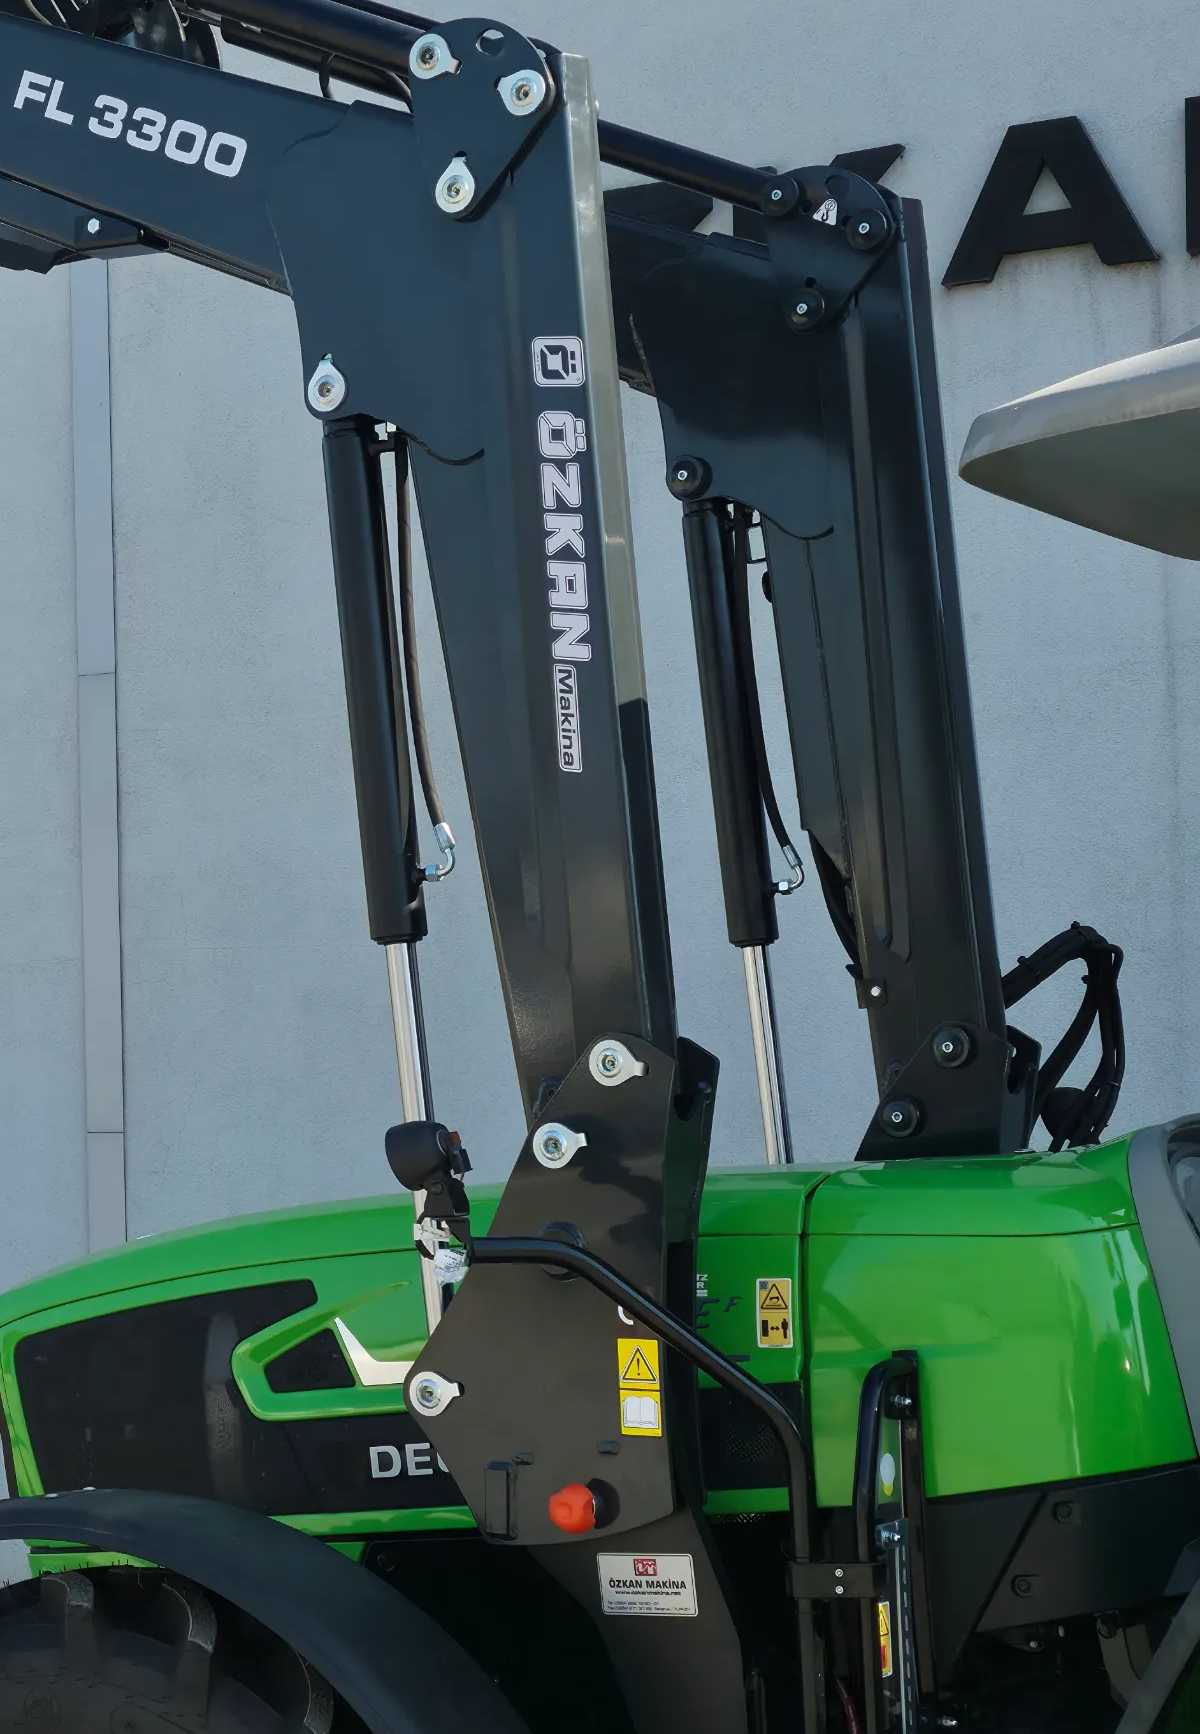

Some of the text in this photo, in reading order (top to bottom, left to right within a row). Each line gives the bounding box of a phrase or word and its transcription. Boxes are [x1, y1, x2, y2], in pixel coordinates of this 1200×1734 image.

[13, 70, 247, 178] FL 3300
[538, 410, 591, 769] ÖZKAN Makina
[369, 1442, 450, 1479] DE
[608, 1578, 687, 1589] ÖZKAN MAKİNA
